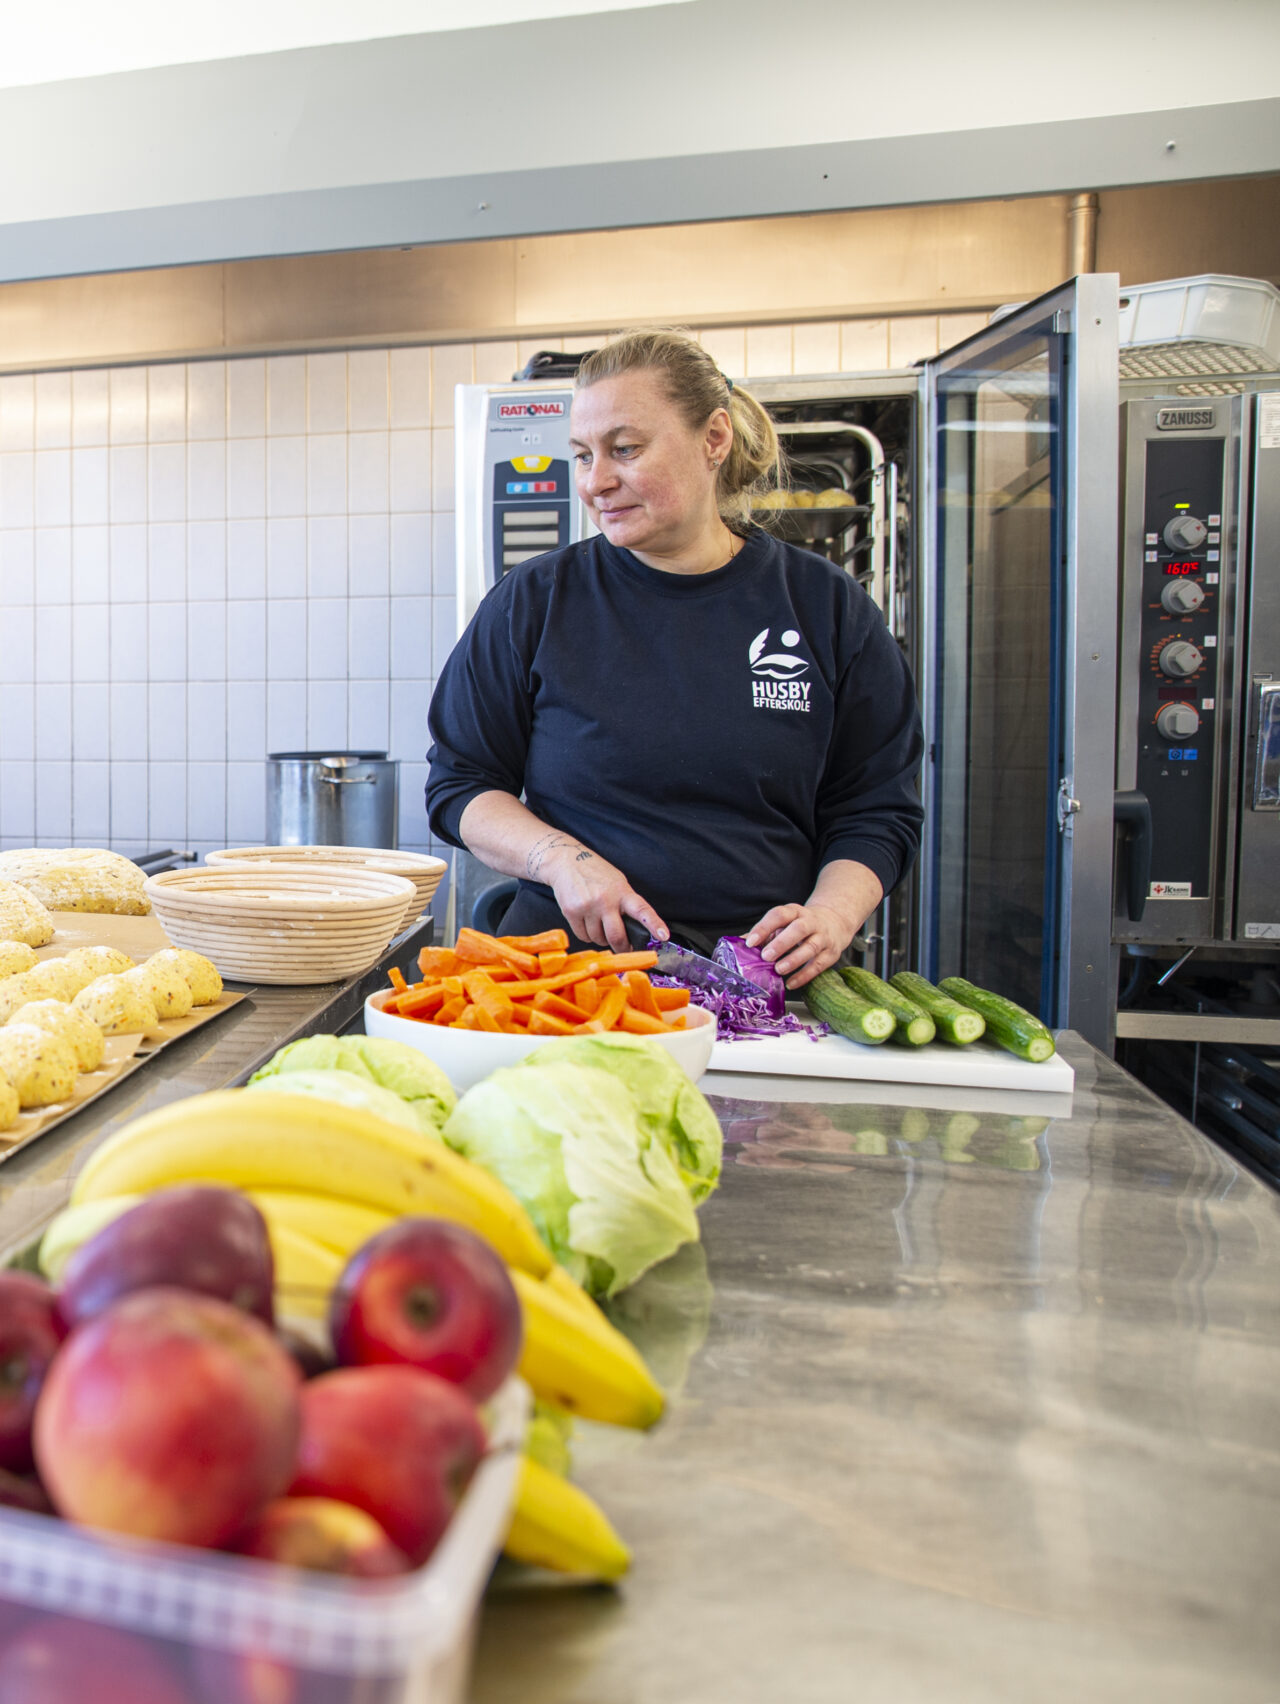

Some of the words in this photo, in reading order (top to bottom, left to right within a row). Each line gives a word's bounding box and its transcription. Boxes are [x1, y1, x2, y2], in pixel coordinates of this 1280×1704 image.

[500, 403, 563, 417] RATIONAL
[1161, 411, 1213, 425] ZANUSSI
[751, 680, 812, 700] HUSBY
[753, 696, 812, 713] EFTERSKOLE
